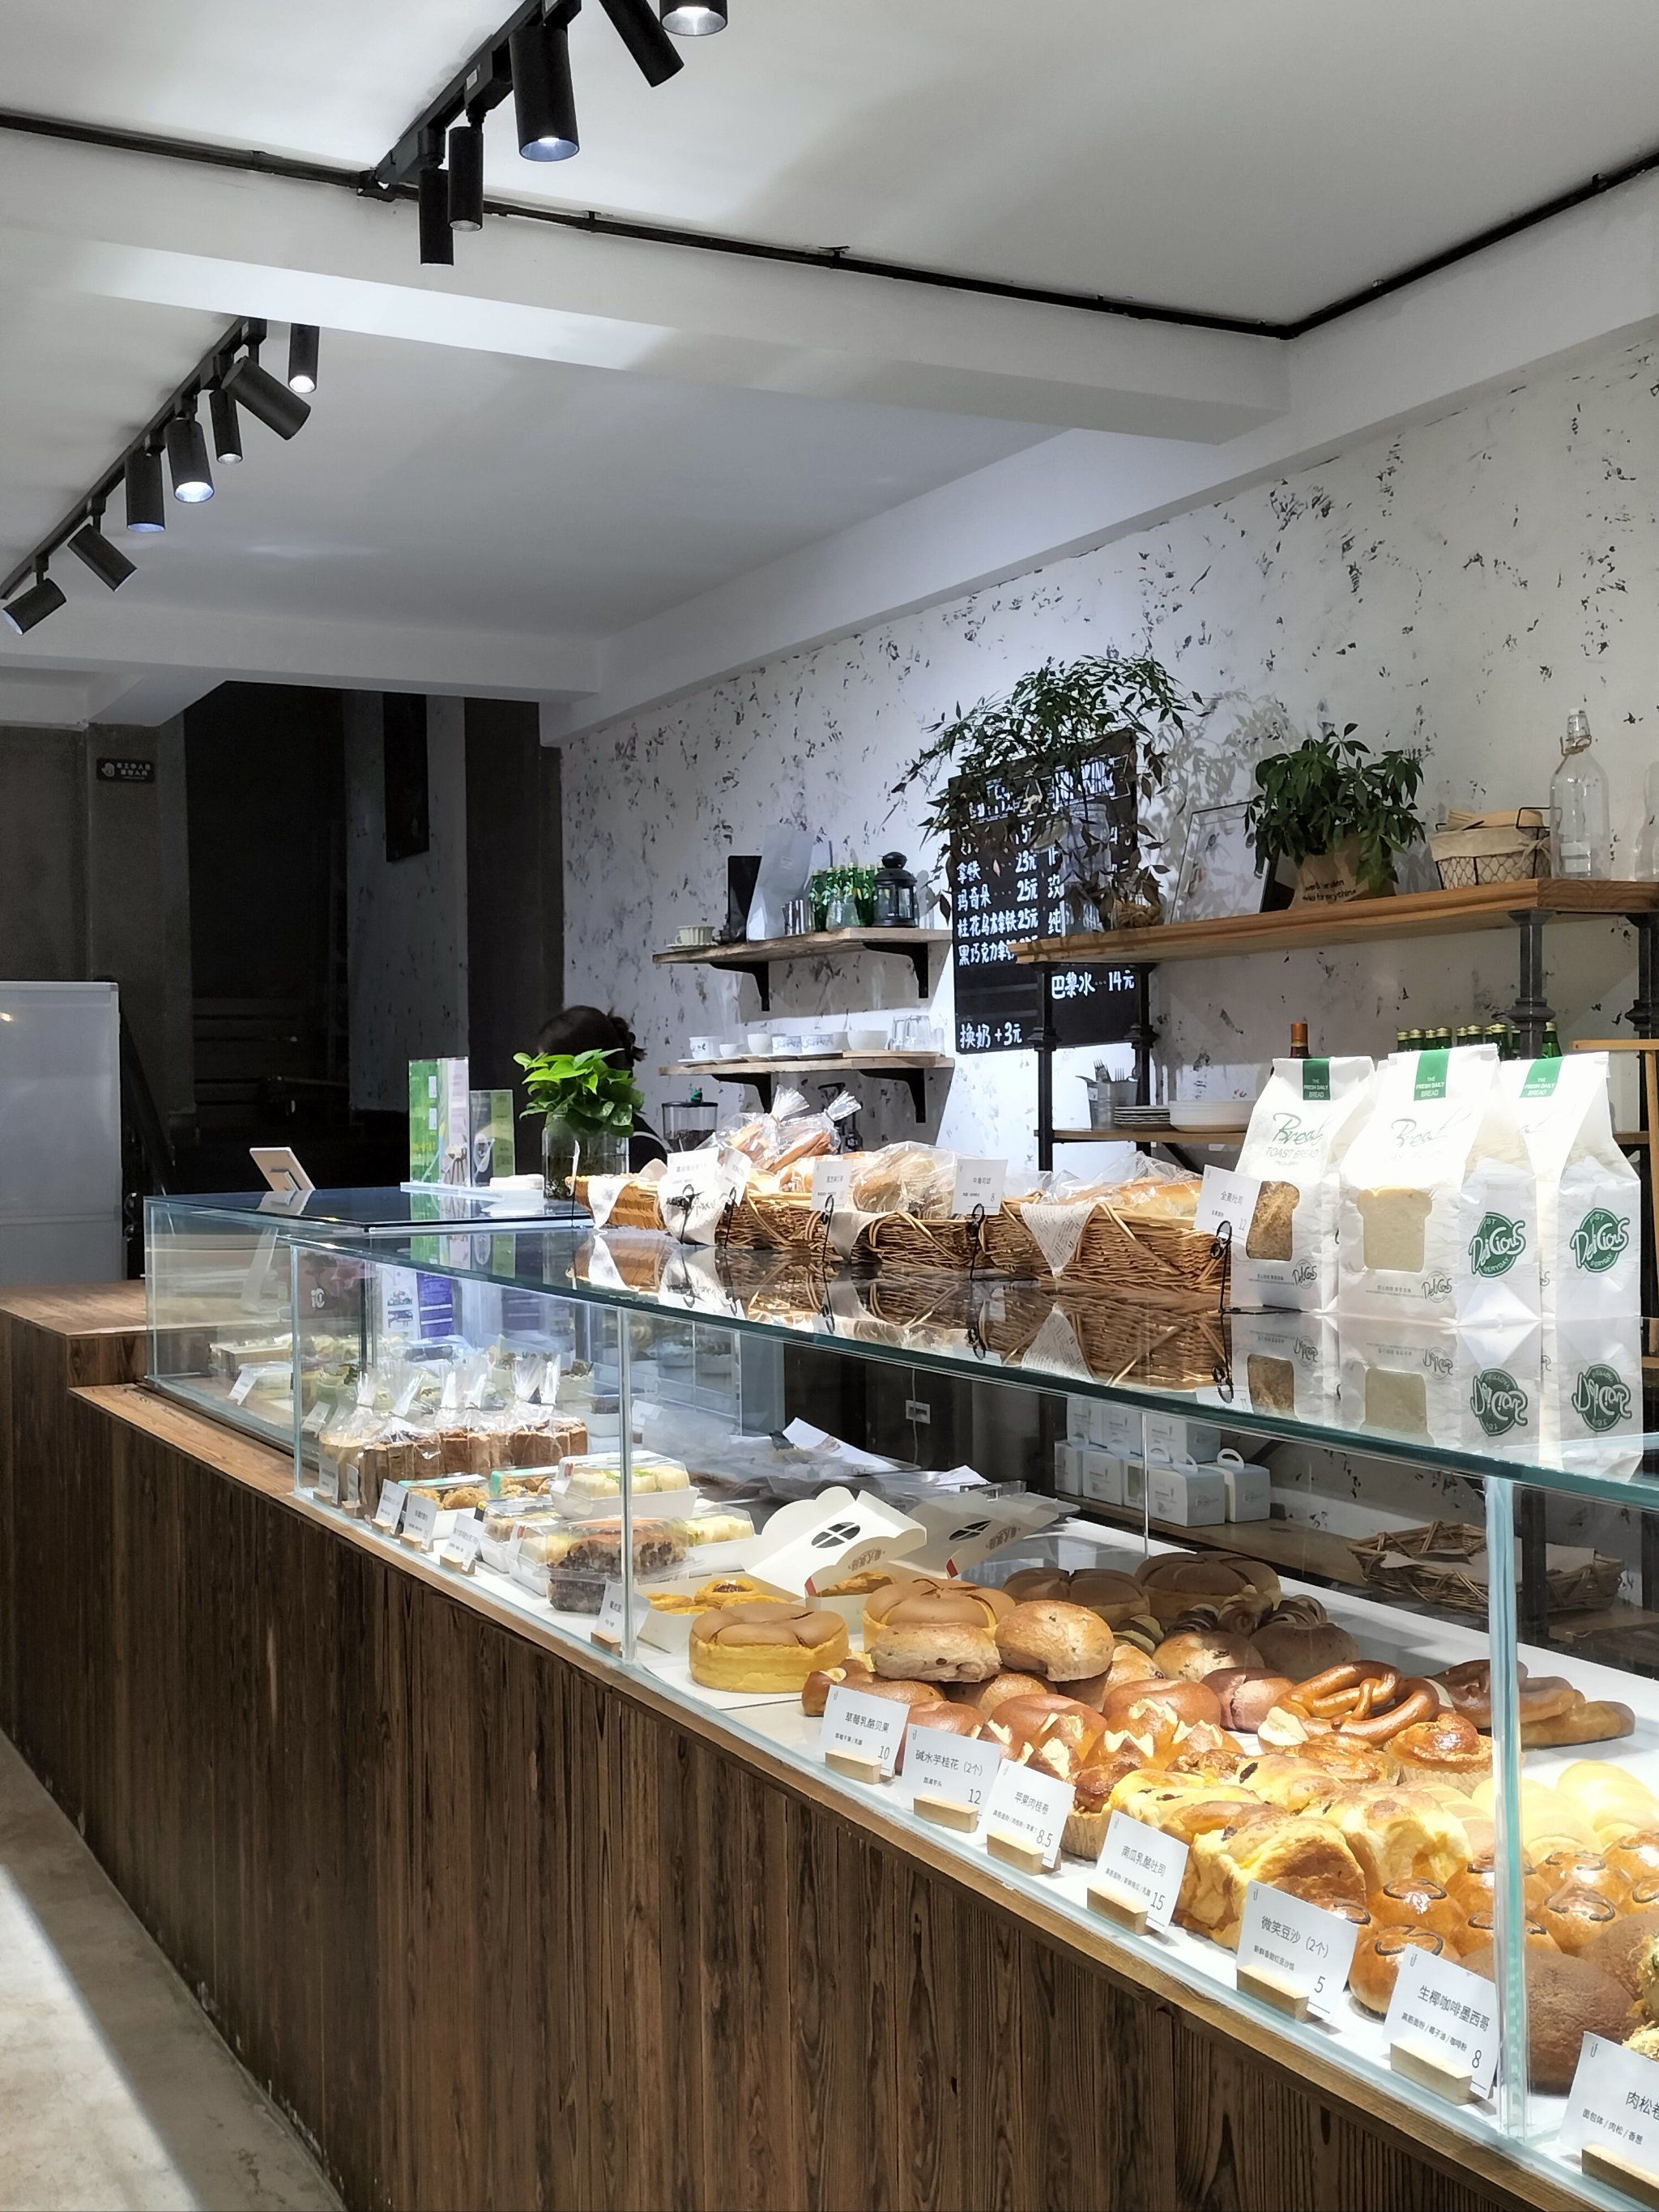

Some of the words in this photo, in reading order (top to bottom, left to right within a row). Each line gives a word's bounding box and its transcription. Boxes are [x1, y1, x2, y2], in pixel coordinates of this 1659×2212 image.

[957, 859, 982, 884] 拿铁
[957, 884, 992, 912] 玛奇朵
[1017, 878, 1038, 902] 25元
[1017, 907, 1038, 930] 25元
[1051, 971, 1096, 999] 巴黎水
[1108, 970, 1135, 992] 14元
[959, 1022, 991, 1050] 换奶
[1220, 1191, 1243, 1206] 全麦吐司
[845, 1711, 890, 1733] 草莓乳酪贝果
[878, 1745, 891, 1760] 10
[967, 1788, 983, 1805] 12
[1036, 1829, 1053, 1848] 8.5
[1121, 1844, 1167, 1877] 南瓜乳酪吐司
[1150, 1891, 1166, 1911] 15
[1314, 1975, 1326, 1993] 5
[1418, 1984, 1491, 2033] 生椰咖啡墨西哥
[1471, 2049, 1482, 2069] 8
